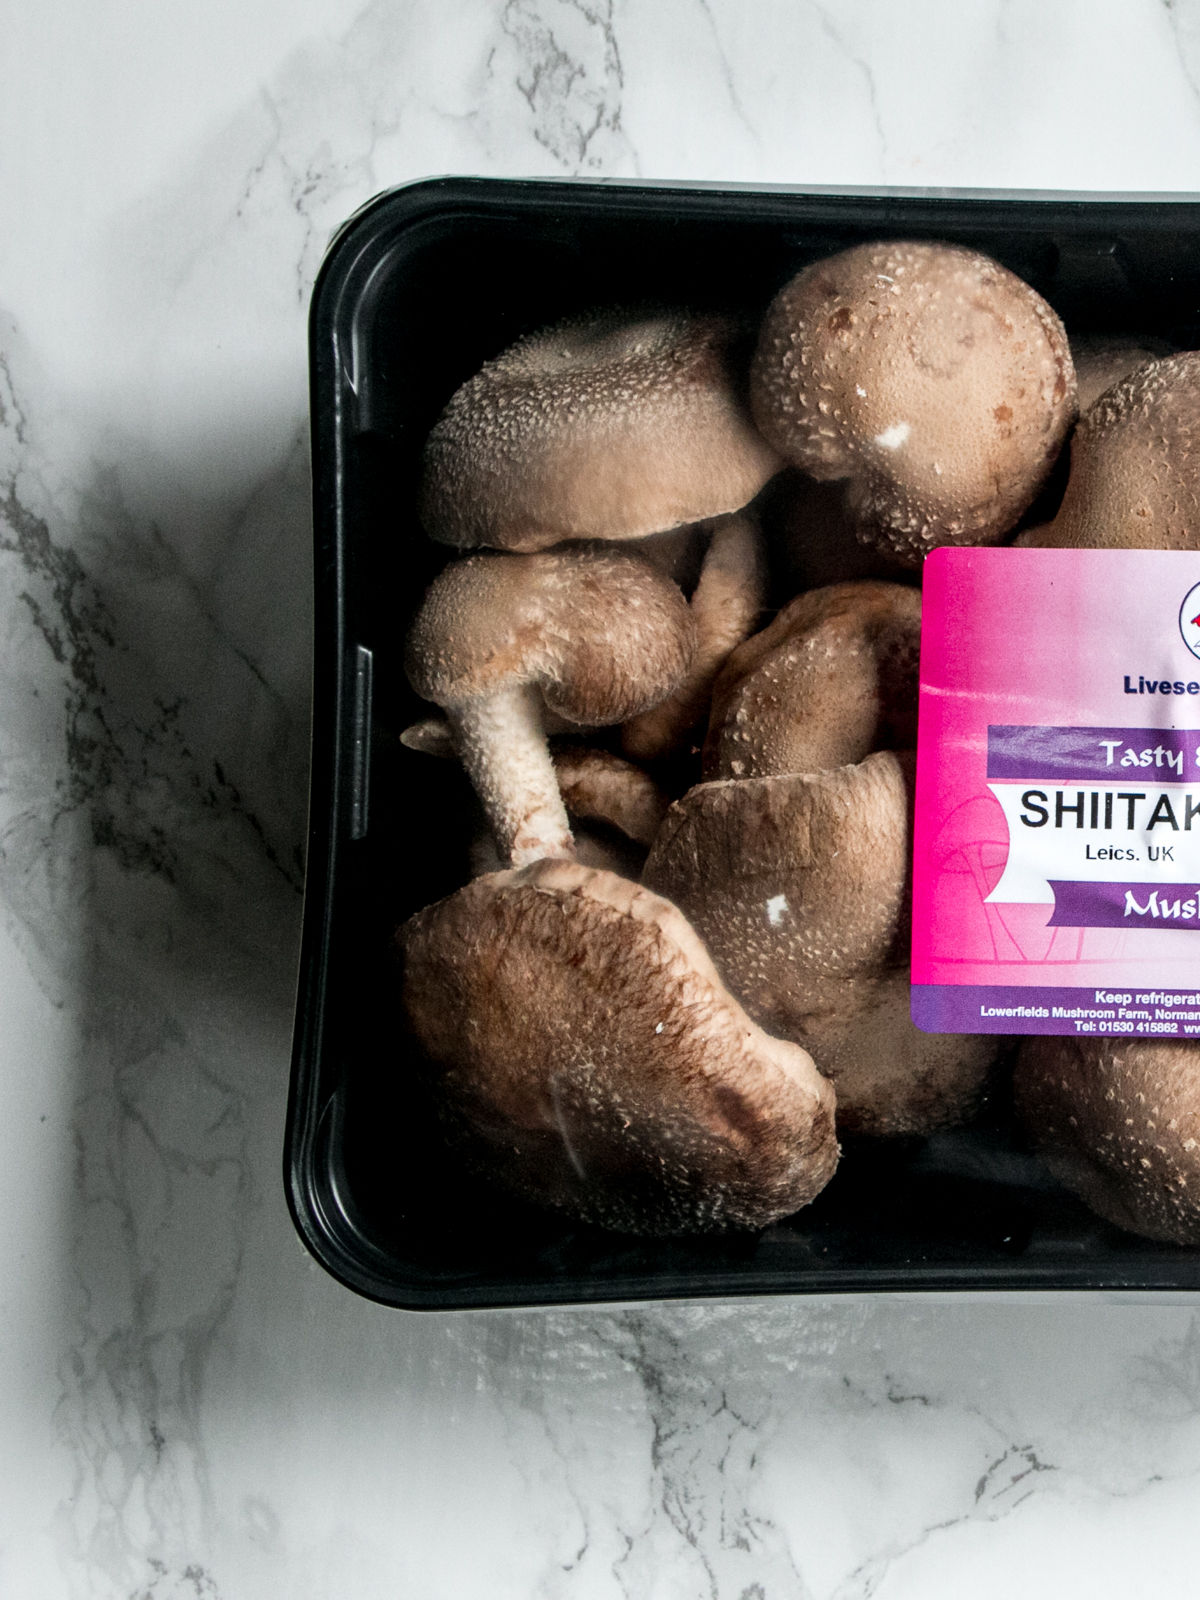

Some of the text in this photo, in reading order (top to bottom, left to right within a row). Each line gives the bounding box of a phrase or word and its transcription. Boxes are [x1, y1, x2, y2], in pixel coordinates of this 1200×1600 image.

[1099, 741, 1183, 774] Tasty
[1085, 844, 1174, 861] Leics. UK
[1095, 990, 1132, 1006] Keep
[980, 1005, 1049, 1018] Lowerfields
[1052, 1007, 1115, 1019] Mushroom
[1118, 1009, 1152, 1021] Farm,
[1075, 1020, 1096, 1033] Tel:
[1099, 1021, 1134, 1033] 01530
[1136, 1021, 1178, 1033] 415862
